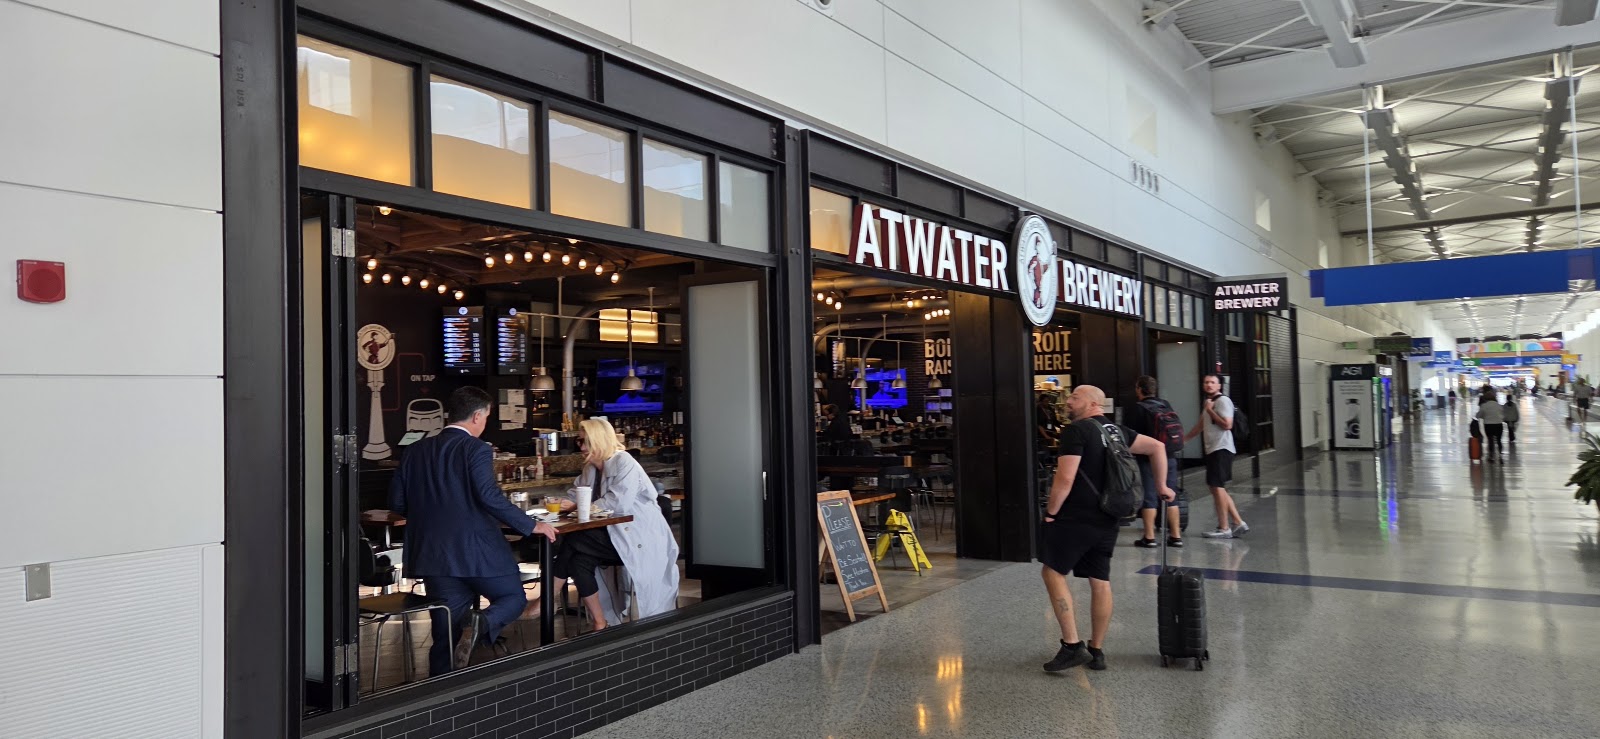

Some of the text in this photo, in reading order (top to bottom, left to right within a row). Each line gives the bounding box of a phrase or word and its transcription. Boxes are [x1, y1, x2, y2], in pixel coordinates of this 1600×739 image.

[855, 203, 1009, 291] ATWATER
[1062, 260, 1142, 316] BREWERY
[1214, 283, 1280, 296] ATWATER
[1214, 296, 1281, 310] BREWERY
[1034, 353, 1071, 371] HERE
